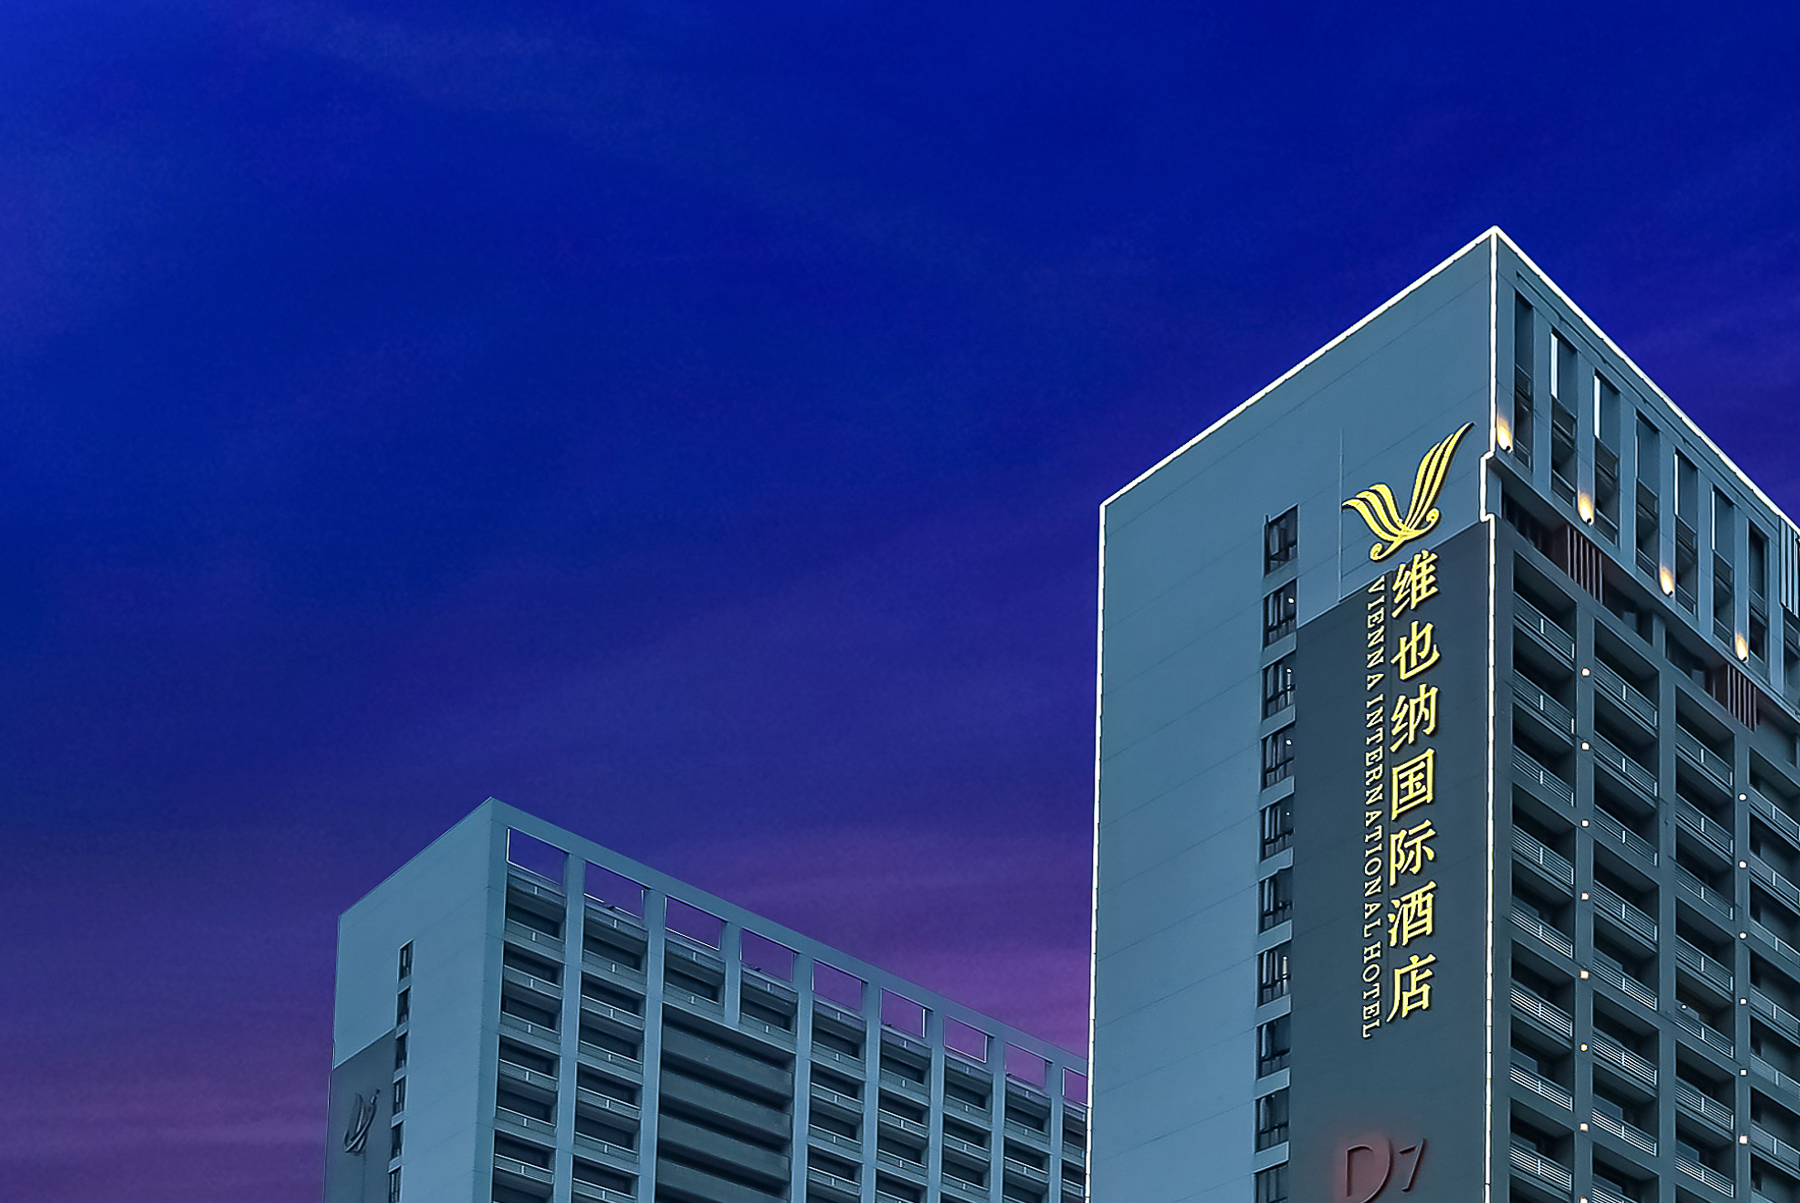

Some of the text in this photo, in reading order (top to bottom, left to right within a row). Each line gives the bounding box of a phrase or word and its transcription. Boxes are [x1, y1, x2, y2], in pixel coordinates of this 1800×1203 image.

[1362, 575, 1386, 1039] VIENNA INTERNATIONAL HOTEL
[1386, 550, 1441, 1023] 维也纳国际酒店
